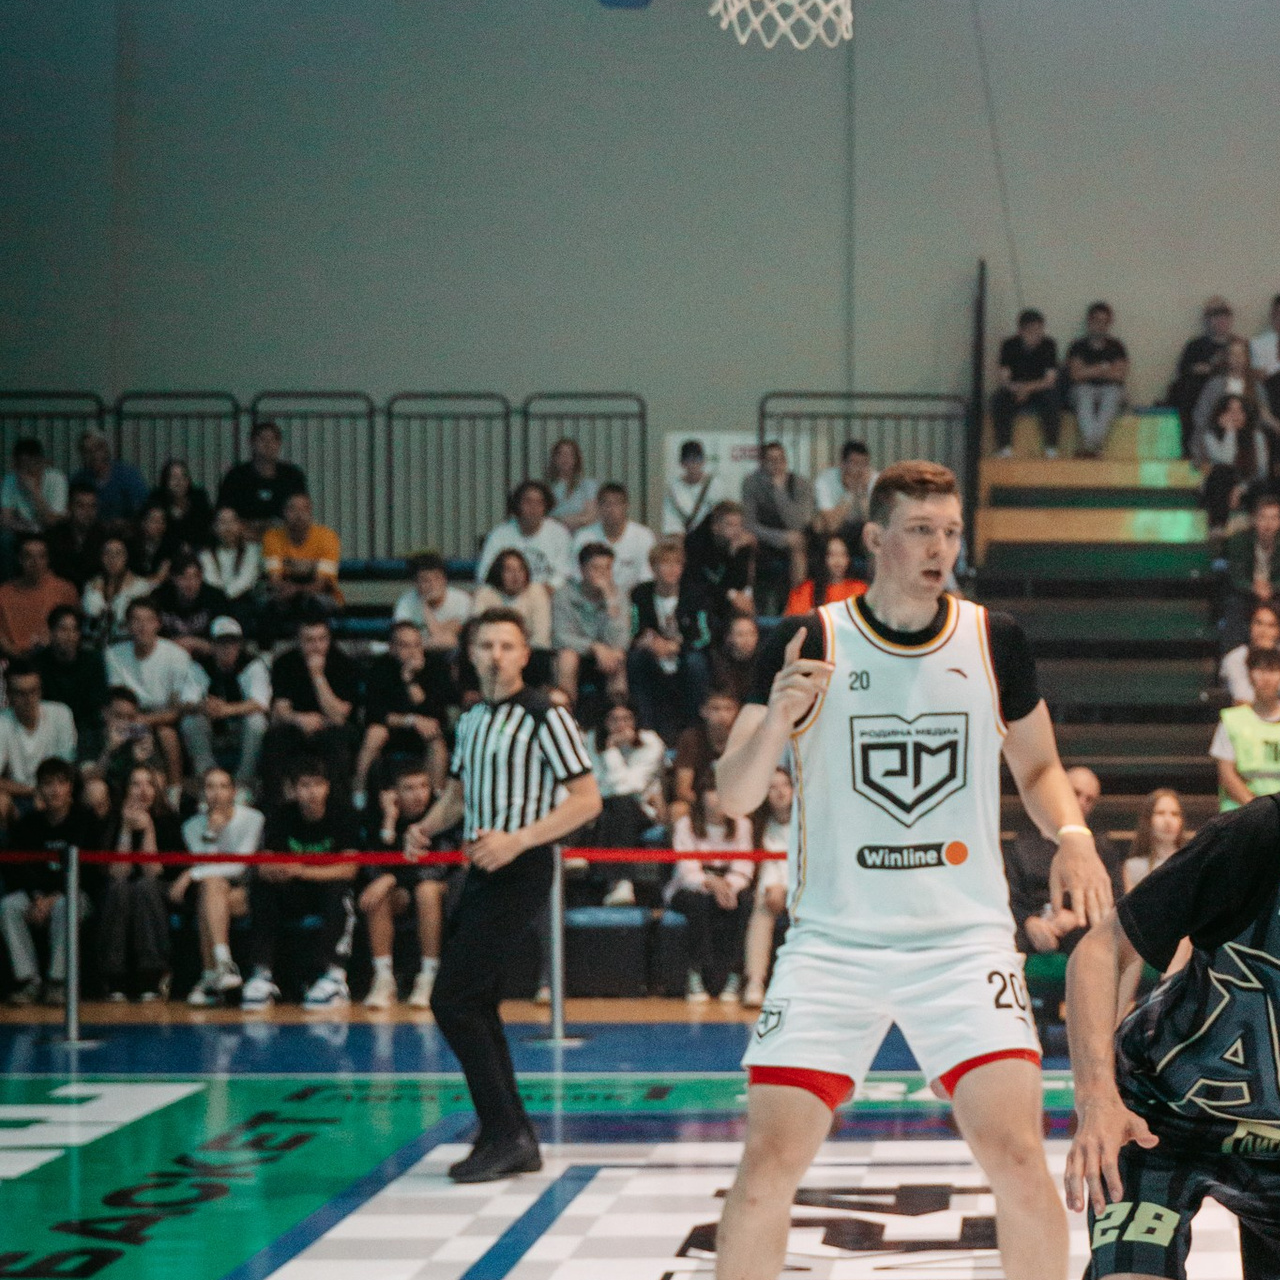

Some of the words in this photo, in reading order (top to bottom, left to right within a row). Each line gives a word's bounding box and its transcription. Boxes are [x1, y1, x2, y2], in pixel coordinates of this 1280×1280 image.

[849, 670, 870, 690] 20
[863, 848, 938, 867] Winline
[1091, 1201, 1181, 1250] 28
